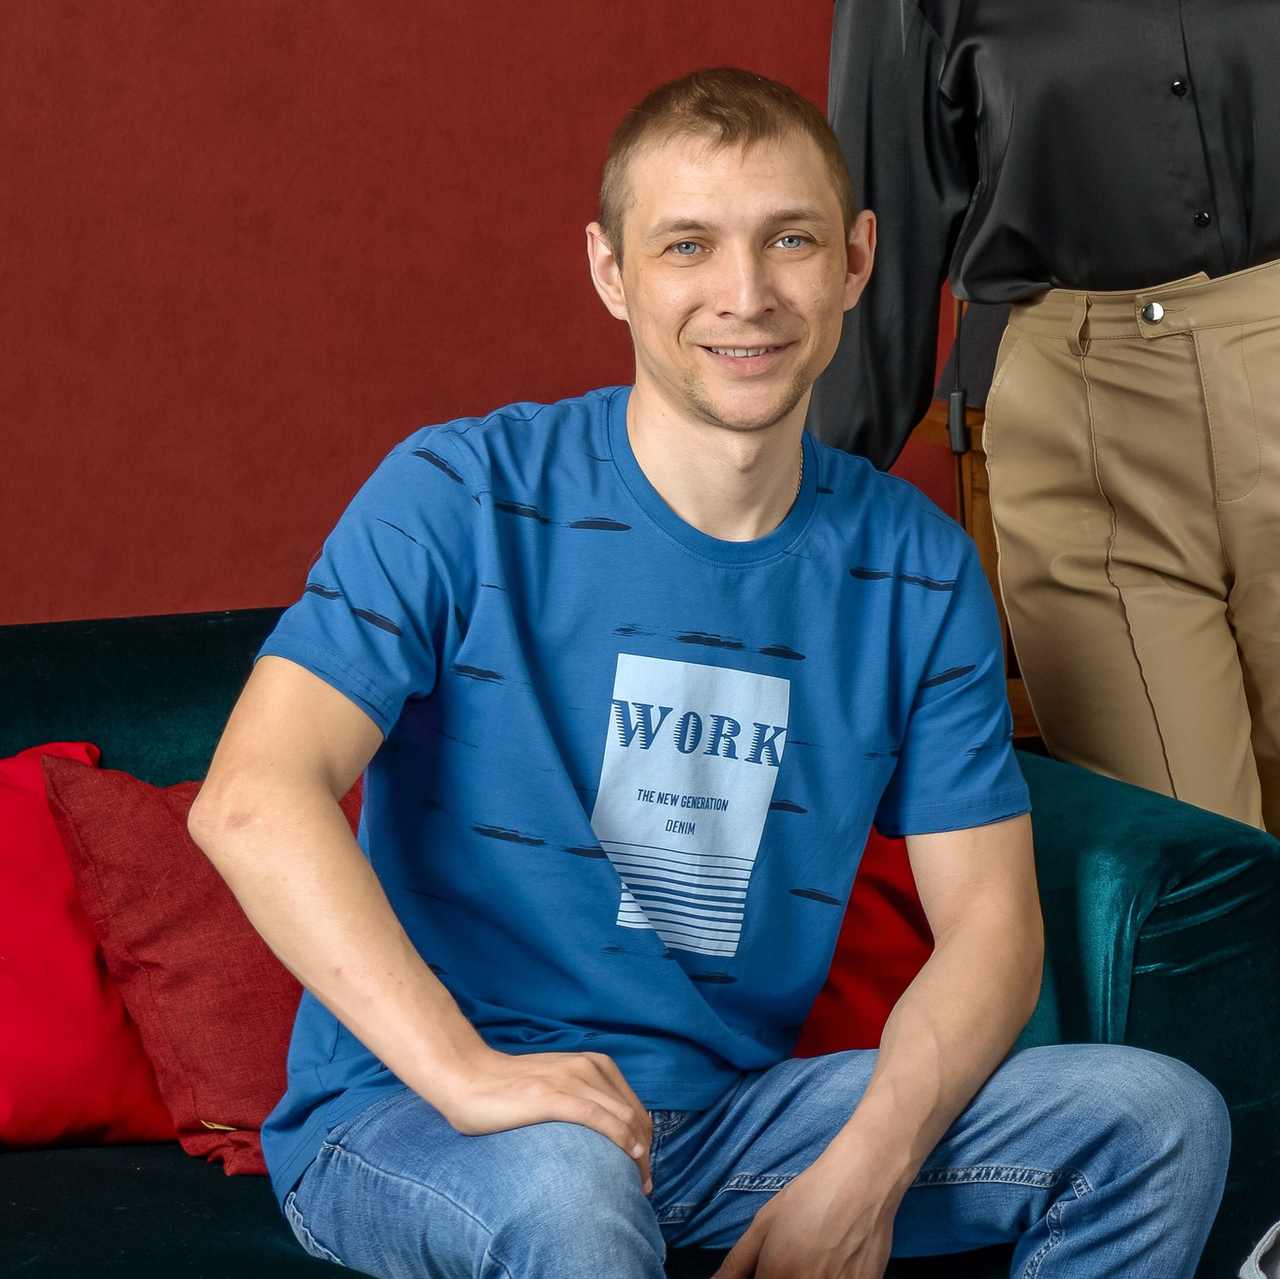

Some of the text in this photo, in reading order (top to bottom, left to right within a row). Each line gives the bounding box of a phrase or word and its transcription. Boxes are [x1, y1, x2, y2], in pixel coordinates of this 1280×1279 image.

[611, 699, 789, 768] WORK
[637, 788, 730, 811] THE NEW GENERATION
[664, 818, 696, 835] DENIM
